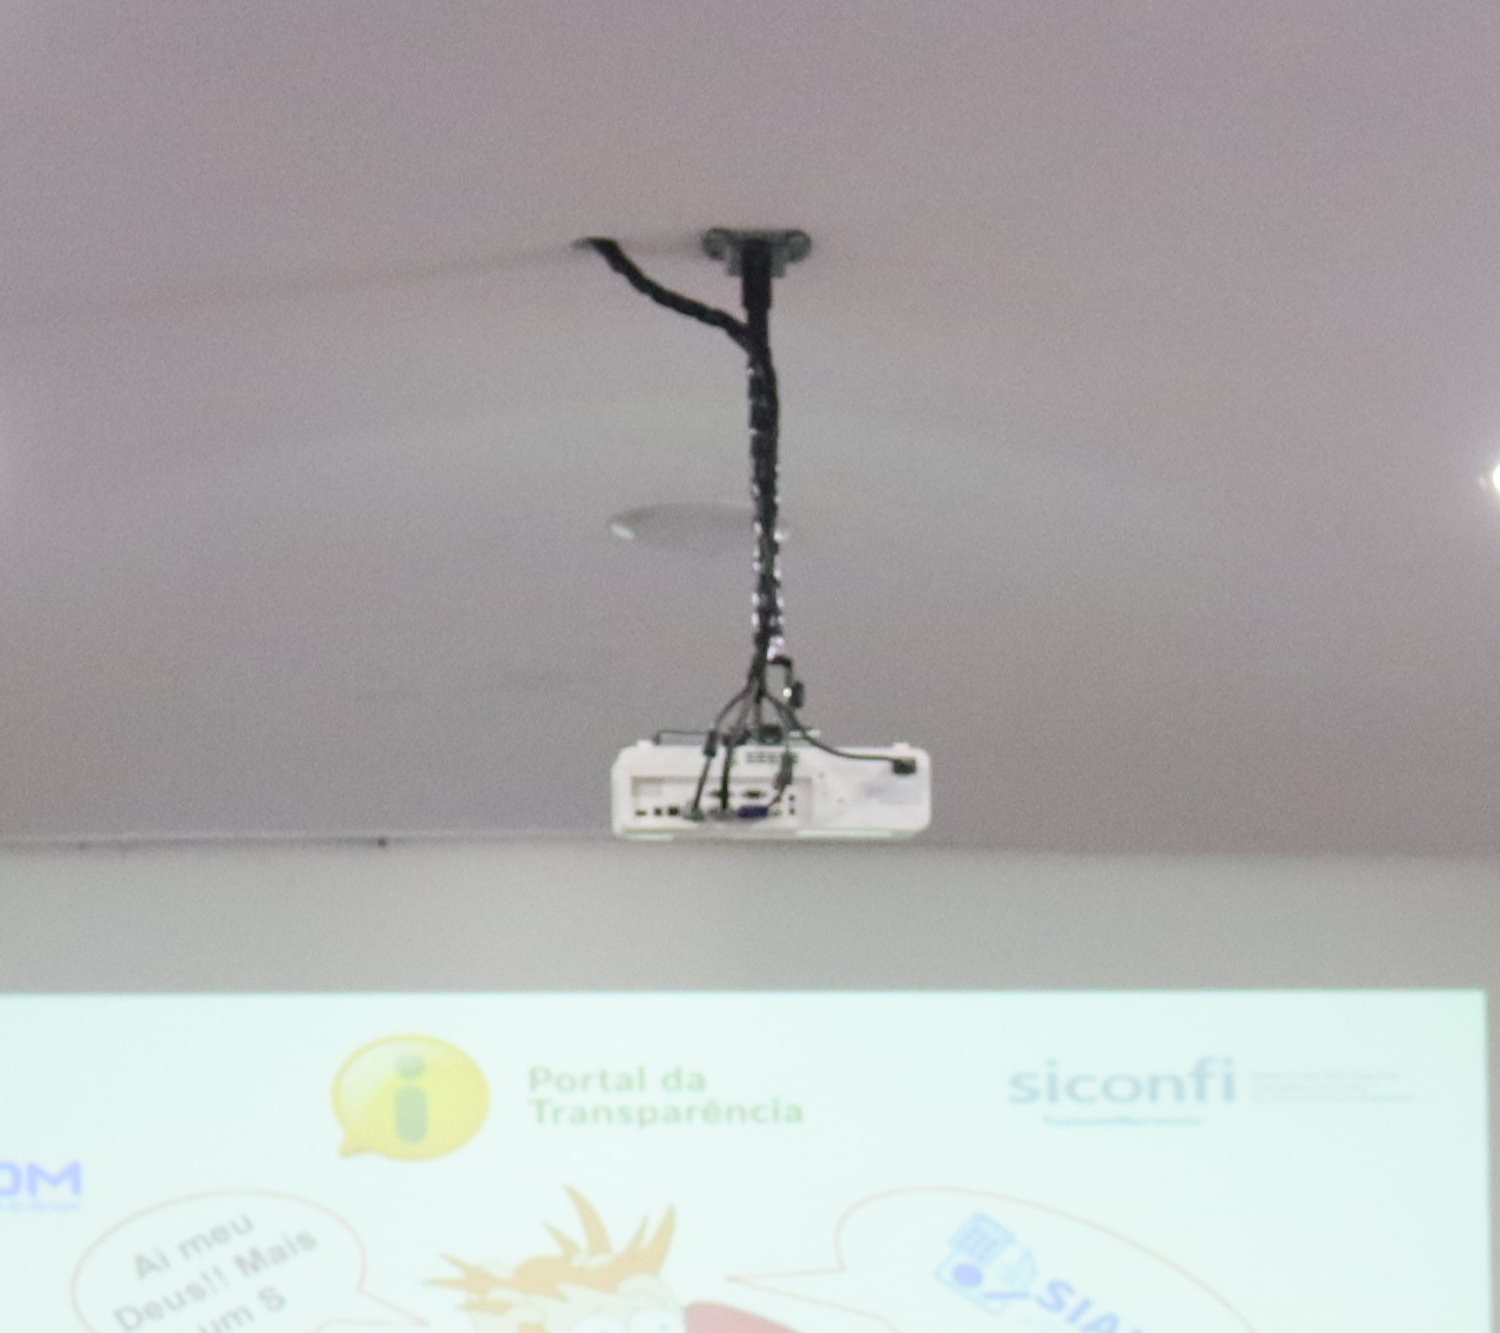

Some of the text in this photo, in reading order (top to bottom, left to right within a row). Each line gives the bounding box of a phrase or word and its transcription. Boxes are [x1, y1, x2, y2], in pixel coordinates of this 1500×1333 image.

[529, 1065, 707, 1094] Portal da
[1008, 1056, 1236, 1104] siconfi
[529, 1097, 806, 1129] Transparência
[134, 1213, 254, 1280] Ai meu
[113, 1231, 317, 1333] Deus!! Mais
